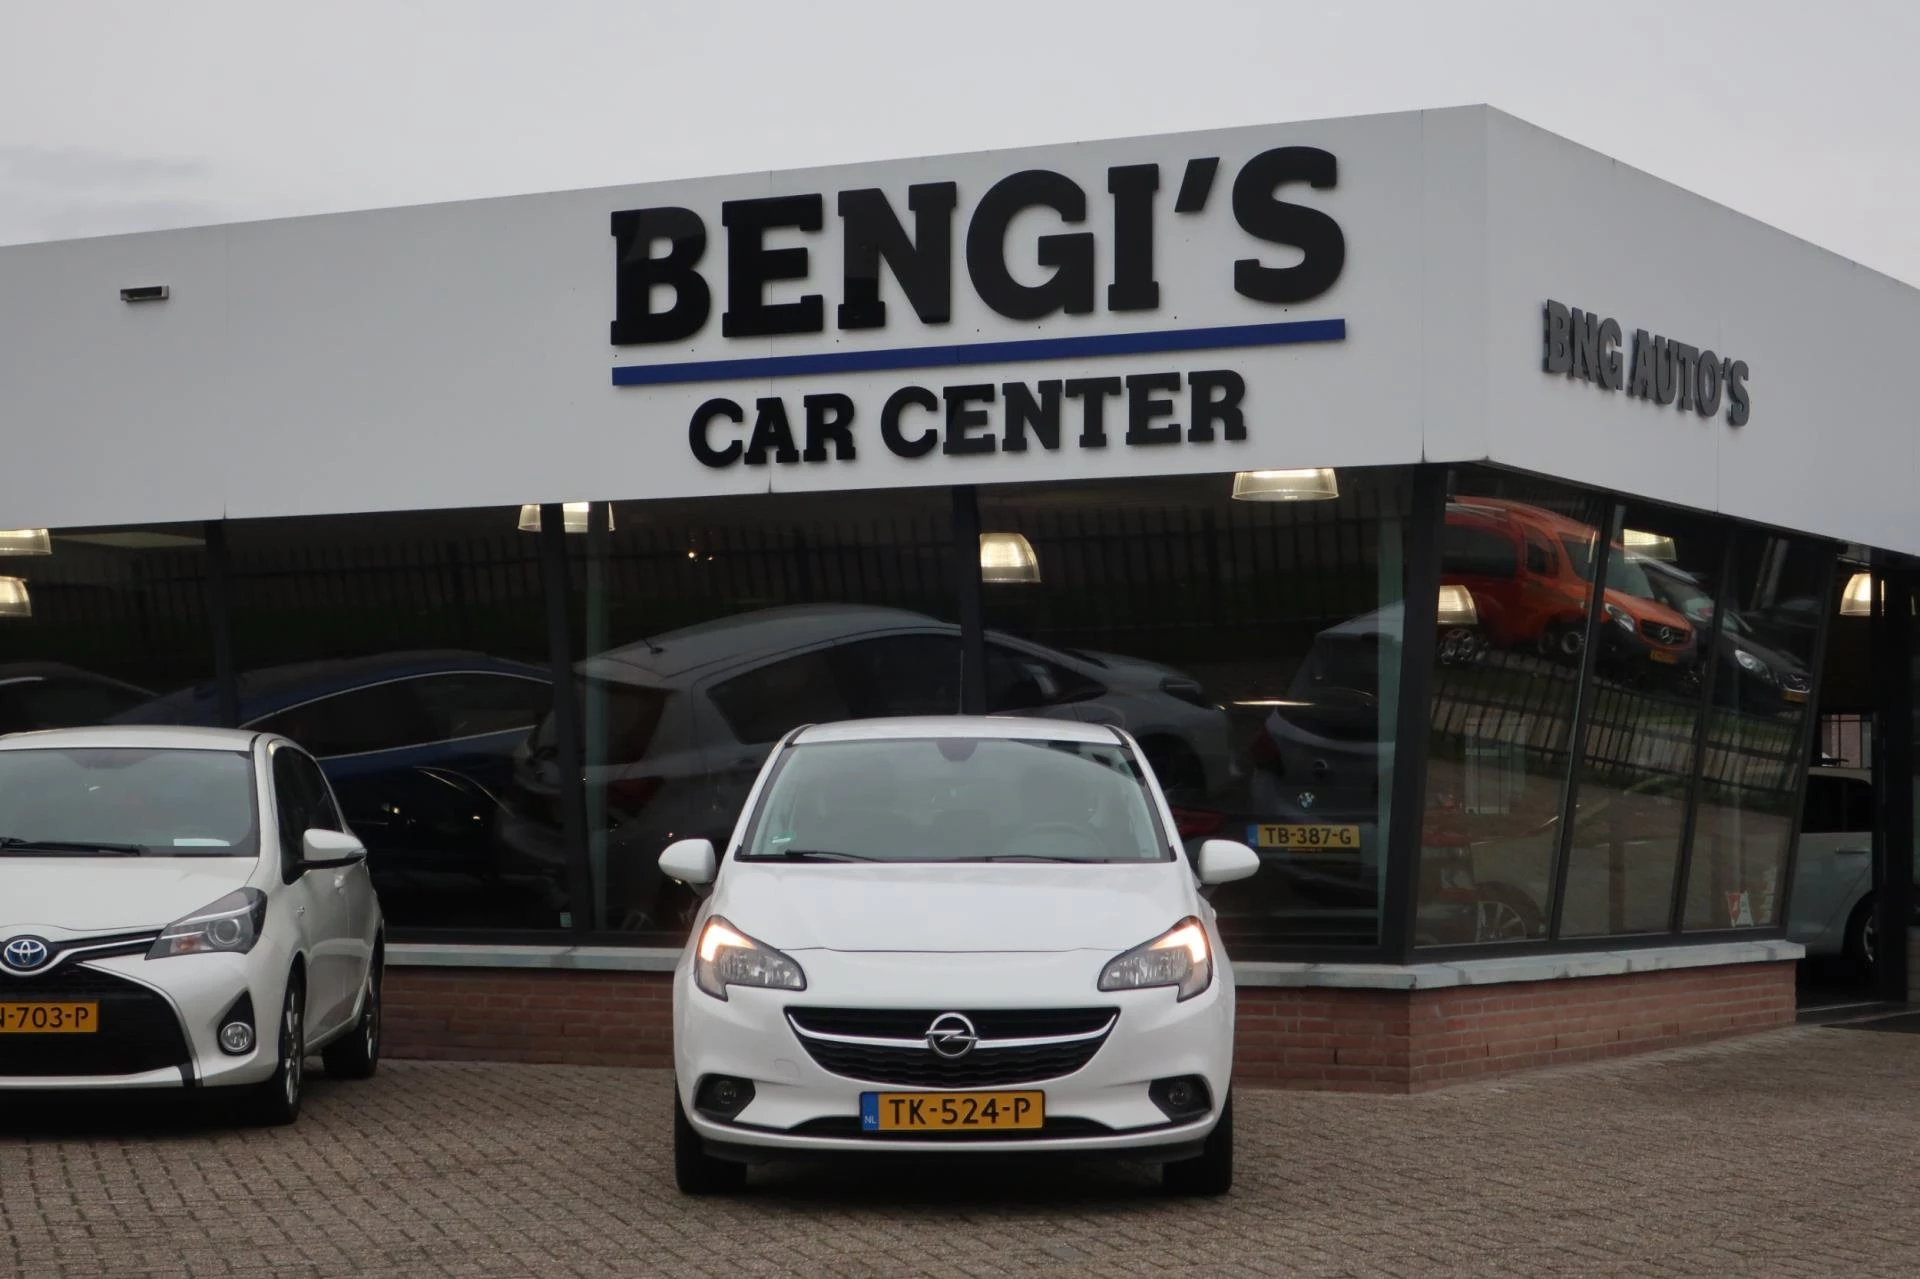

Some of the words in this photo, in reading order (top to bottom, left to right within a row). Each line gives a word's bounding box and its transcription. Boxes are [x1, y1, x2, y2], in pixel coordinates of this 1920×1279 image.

[611, 146, 1345, 345] BENGI'S
[1543, 299, 1623, 390] BNG
[1628, 328, 1749, 427] AUTO'S
[689, 393, 856, 468] CAR
[880, 369, 1247, 458] CENTER
[1265, 827, 1352, 845] TB-387-G
[864, 1115, 877, 1124] NL
[889, 1097, 1031, 1125] TK-524-P
